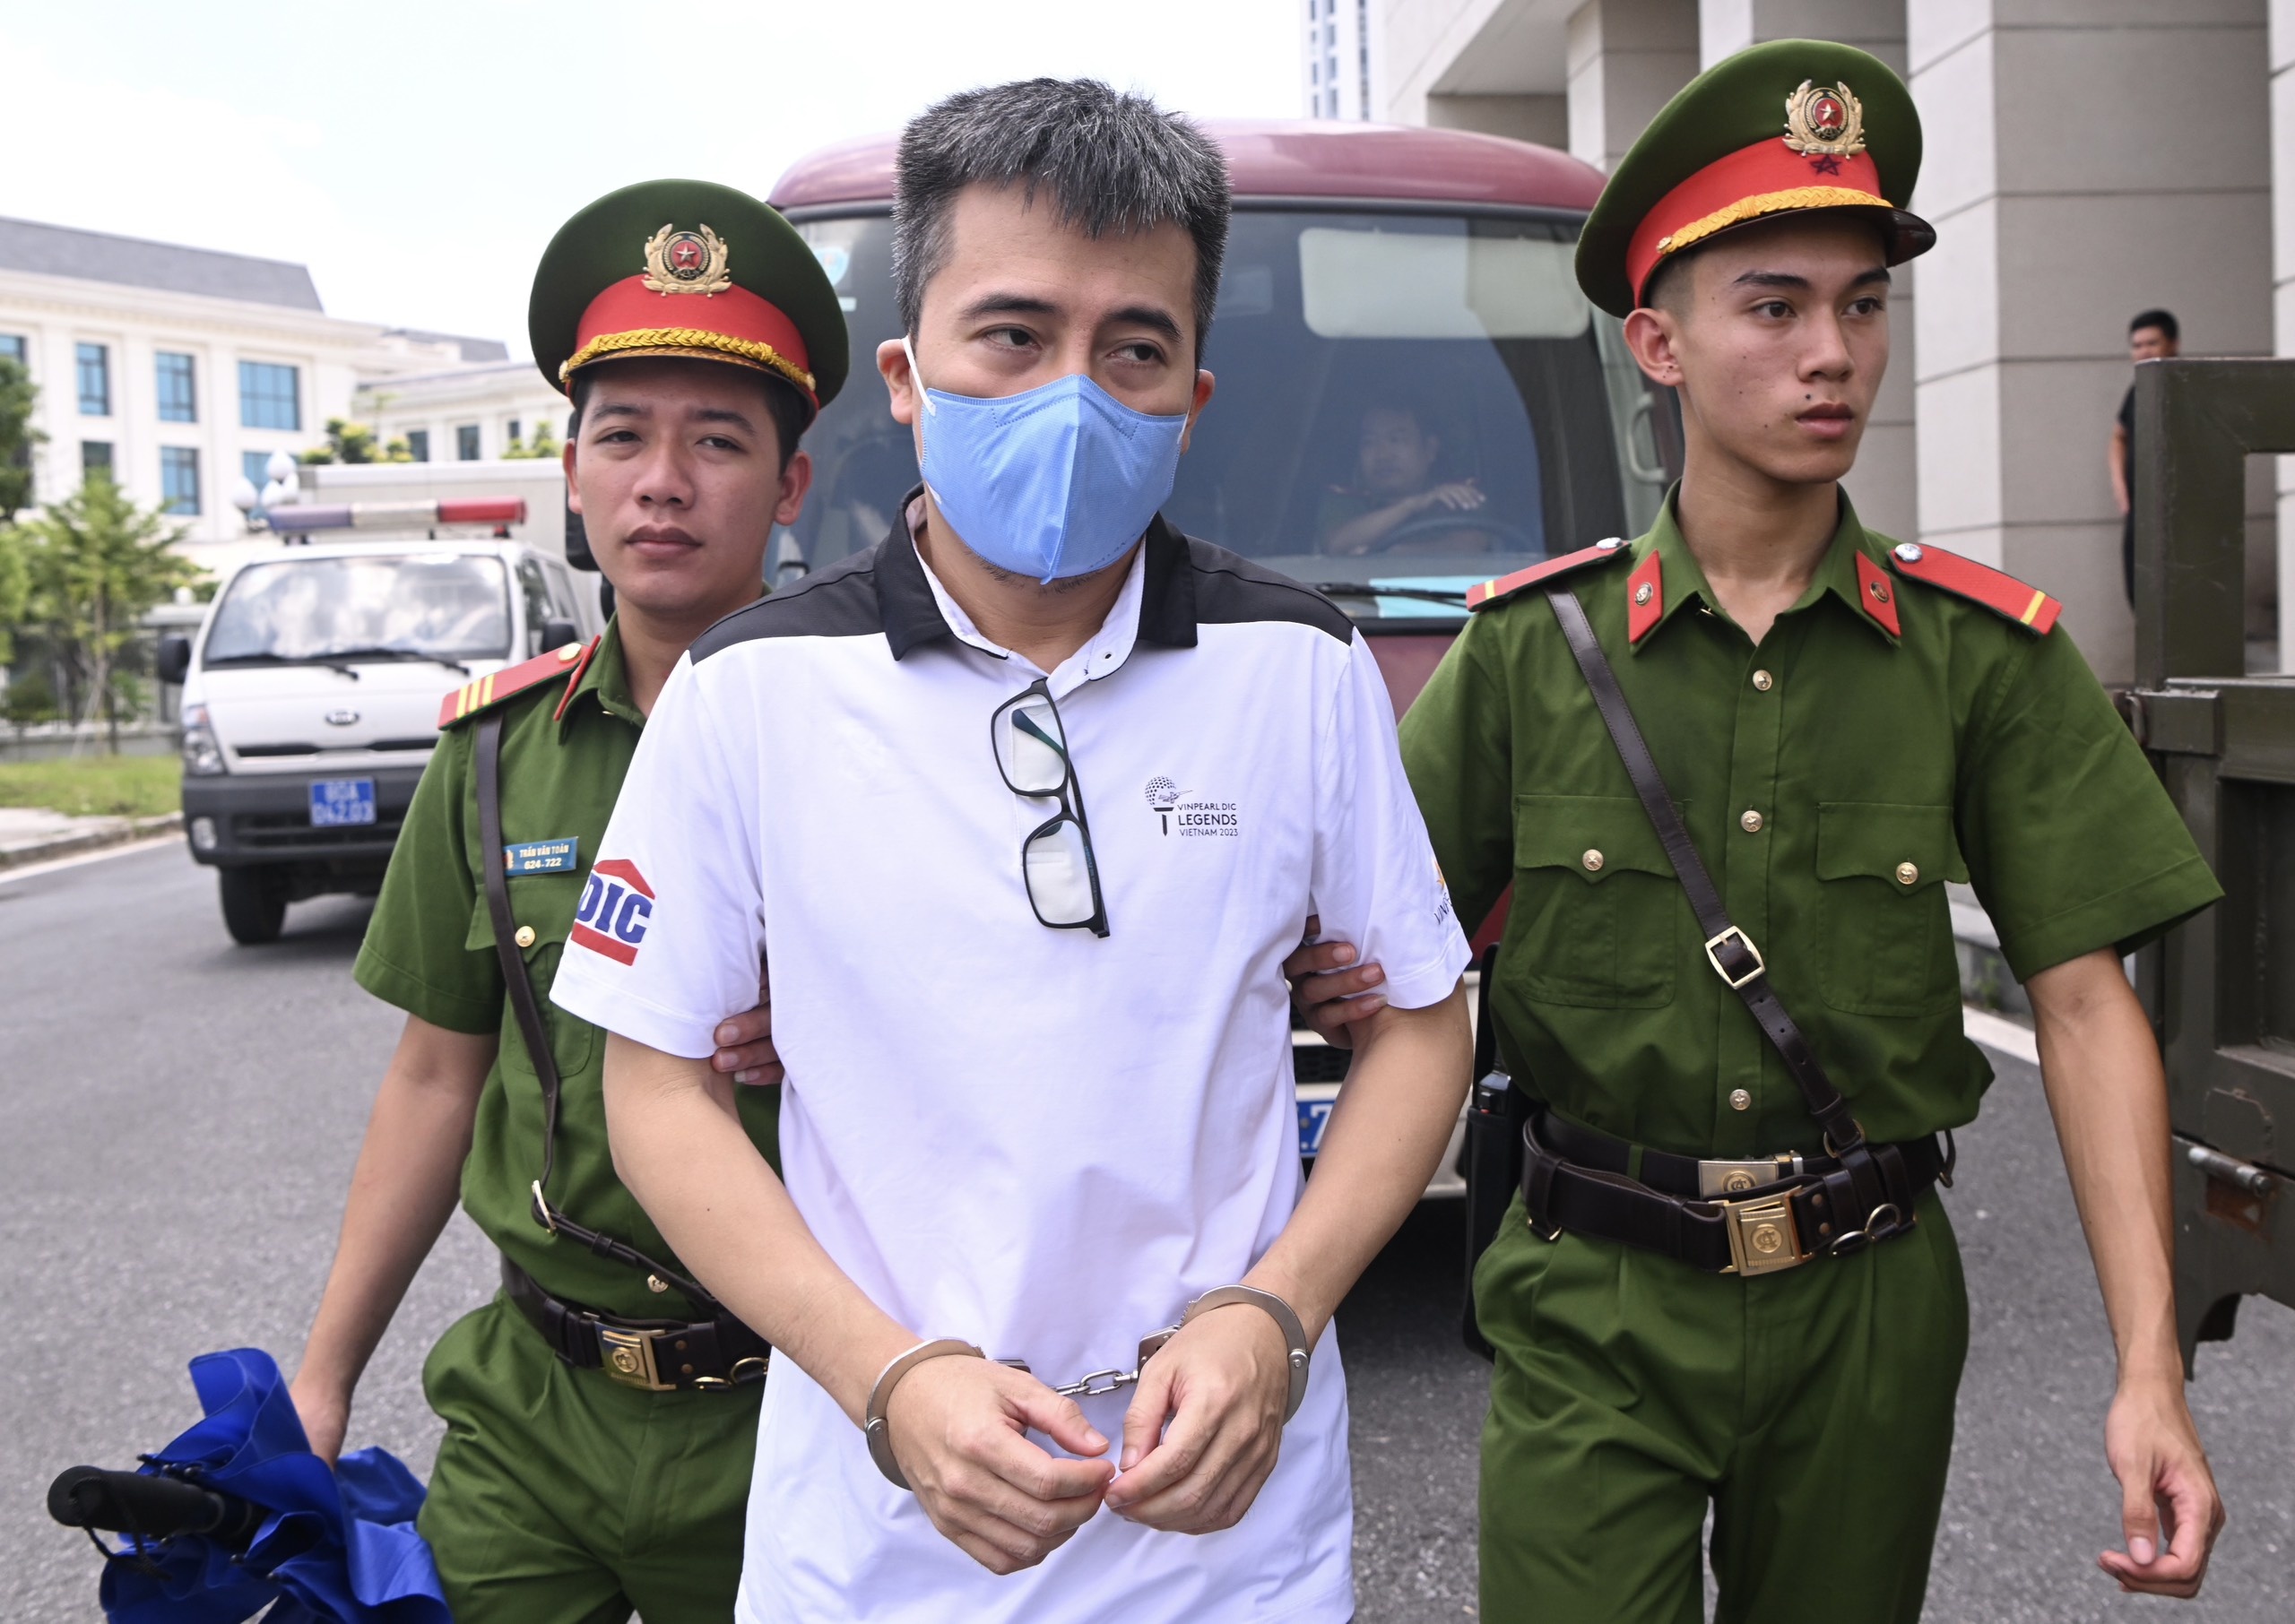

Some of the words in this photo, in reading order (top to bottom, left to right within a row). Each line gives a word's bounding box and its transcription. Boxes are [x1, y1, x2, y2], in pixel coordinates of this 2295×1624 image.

[1177, 803, 1220, 811] VINPEARL
[1222, 803, 1237, 811] DIC
[1178, 814, 1238, 825] LEGENDS
[1180, 828, 1217, 836] VIETNAM
[1219, 828, 1239, 836] 2023
[575, 871, 654, 944] DIC
